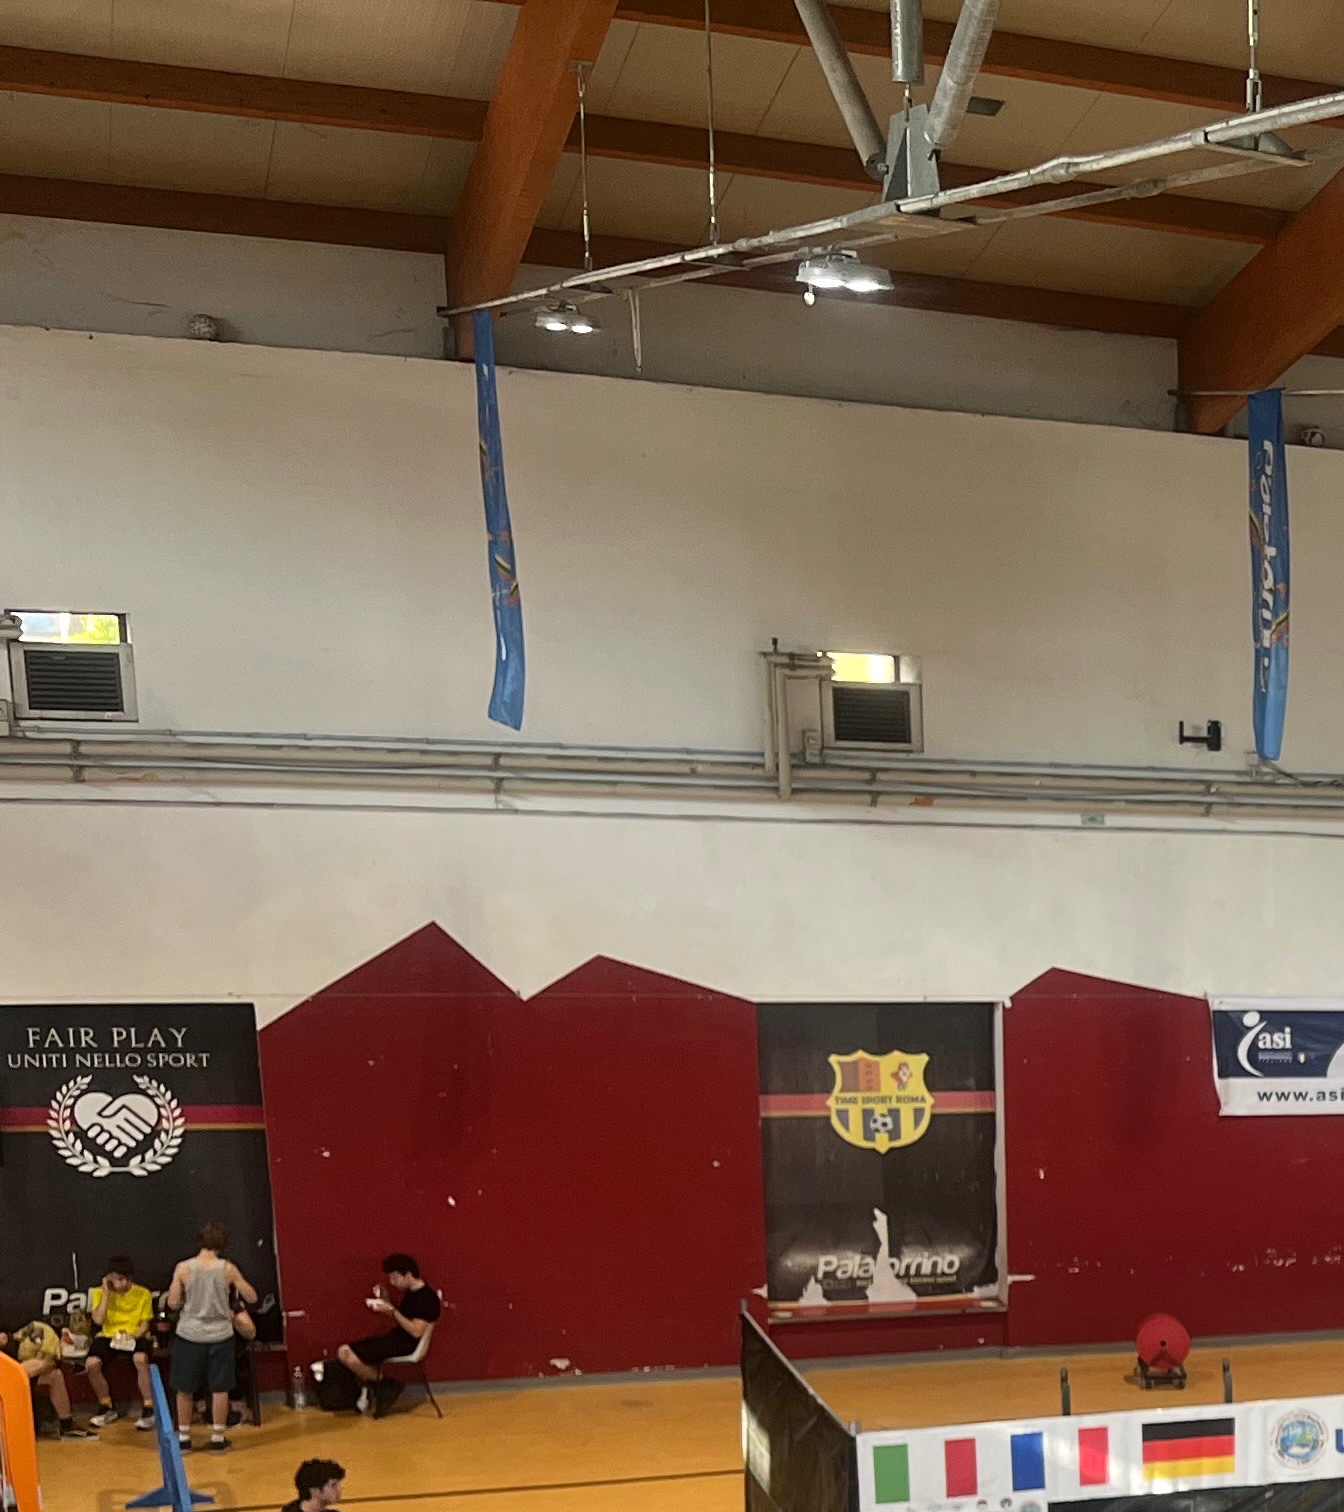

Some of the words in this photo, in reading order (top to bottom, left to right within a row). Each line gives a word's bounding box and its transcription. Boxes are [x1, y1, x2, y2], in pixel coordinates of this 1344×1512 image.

[27, 1027, 98, 1048] FAIR
[111, 1027, 188, 1048] PLAY
[1258, 1026, 1292, 1049] asi
[7, 1053, 67, 1068] UNITI
[75, 1053, 141, 1068] NELLO
[147, 1053, 210, 1068] SPORT
[817, 1252, 960, 1280] Palaorrino
